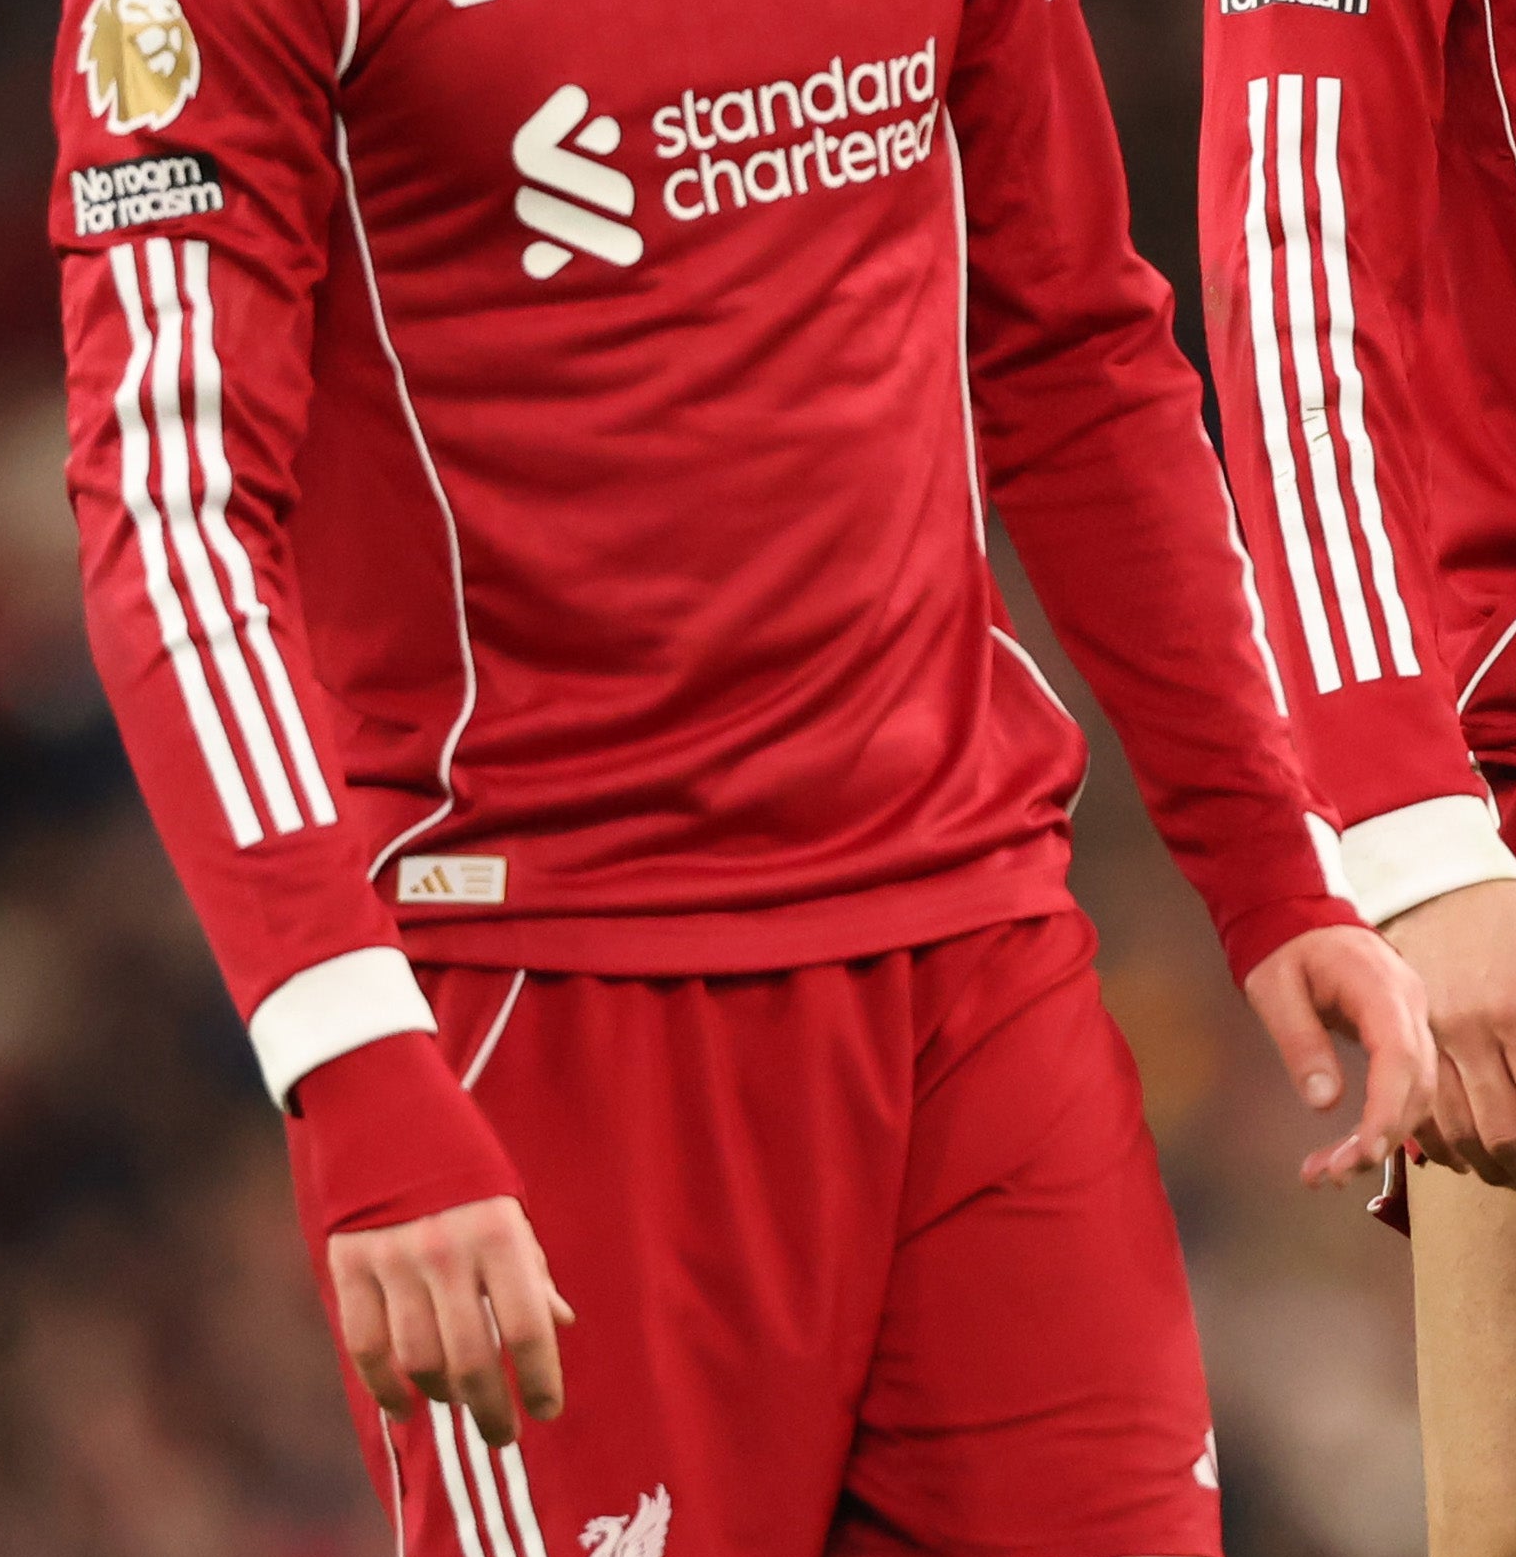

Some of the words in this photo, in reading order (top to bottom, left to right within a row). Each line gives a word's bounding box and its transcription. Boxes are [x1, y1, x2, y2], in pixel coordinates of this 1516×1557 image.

[651, 35, 936, 160] standard
[662, 97, 940, 222] chartered
[69, 166, 114, 203] No
[112, 156, 203, 197] room
